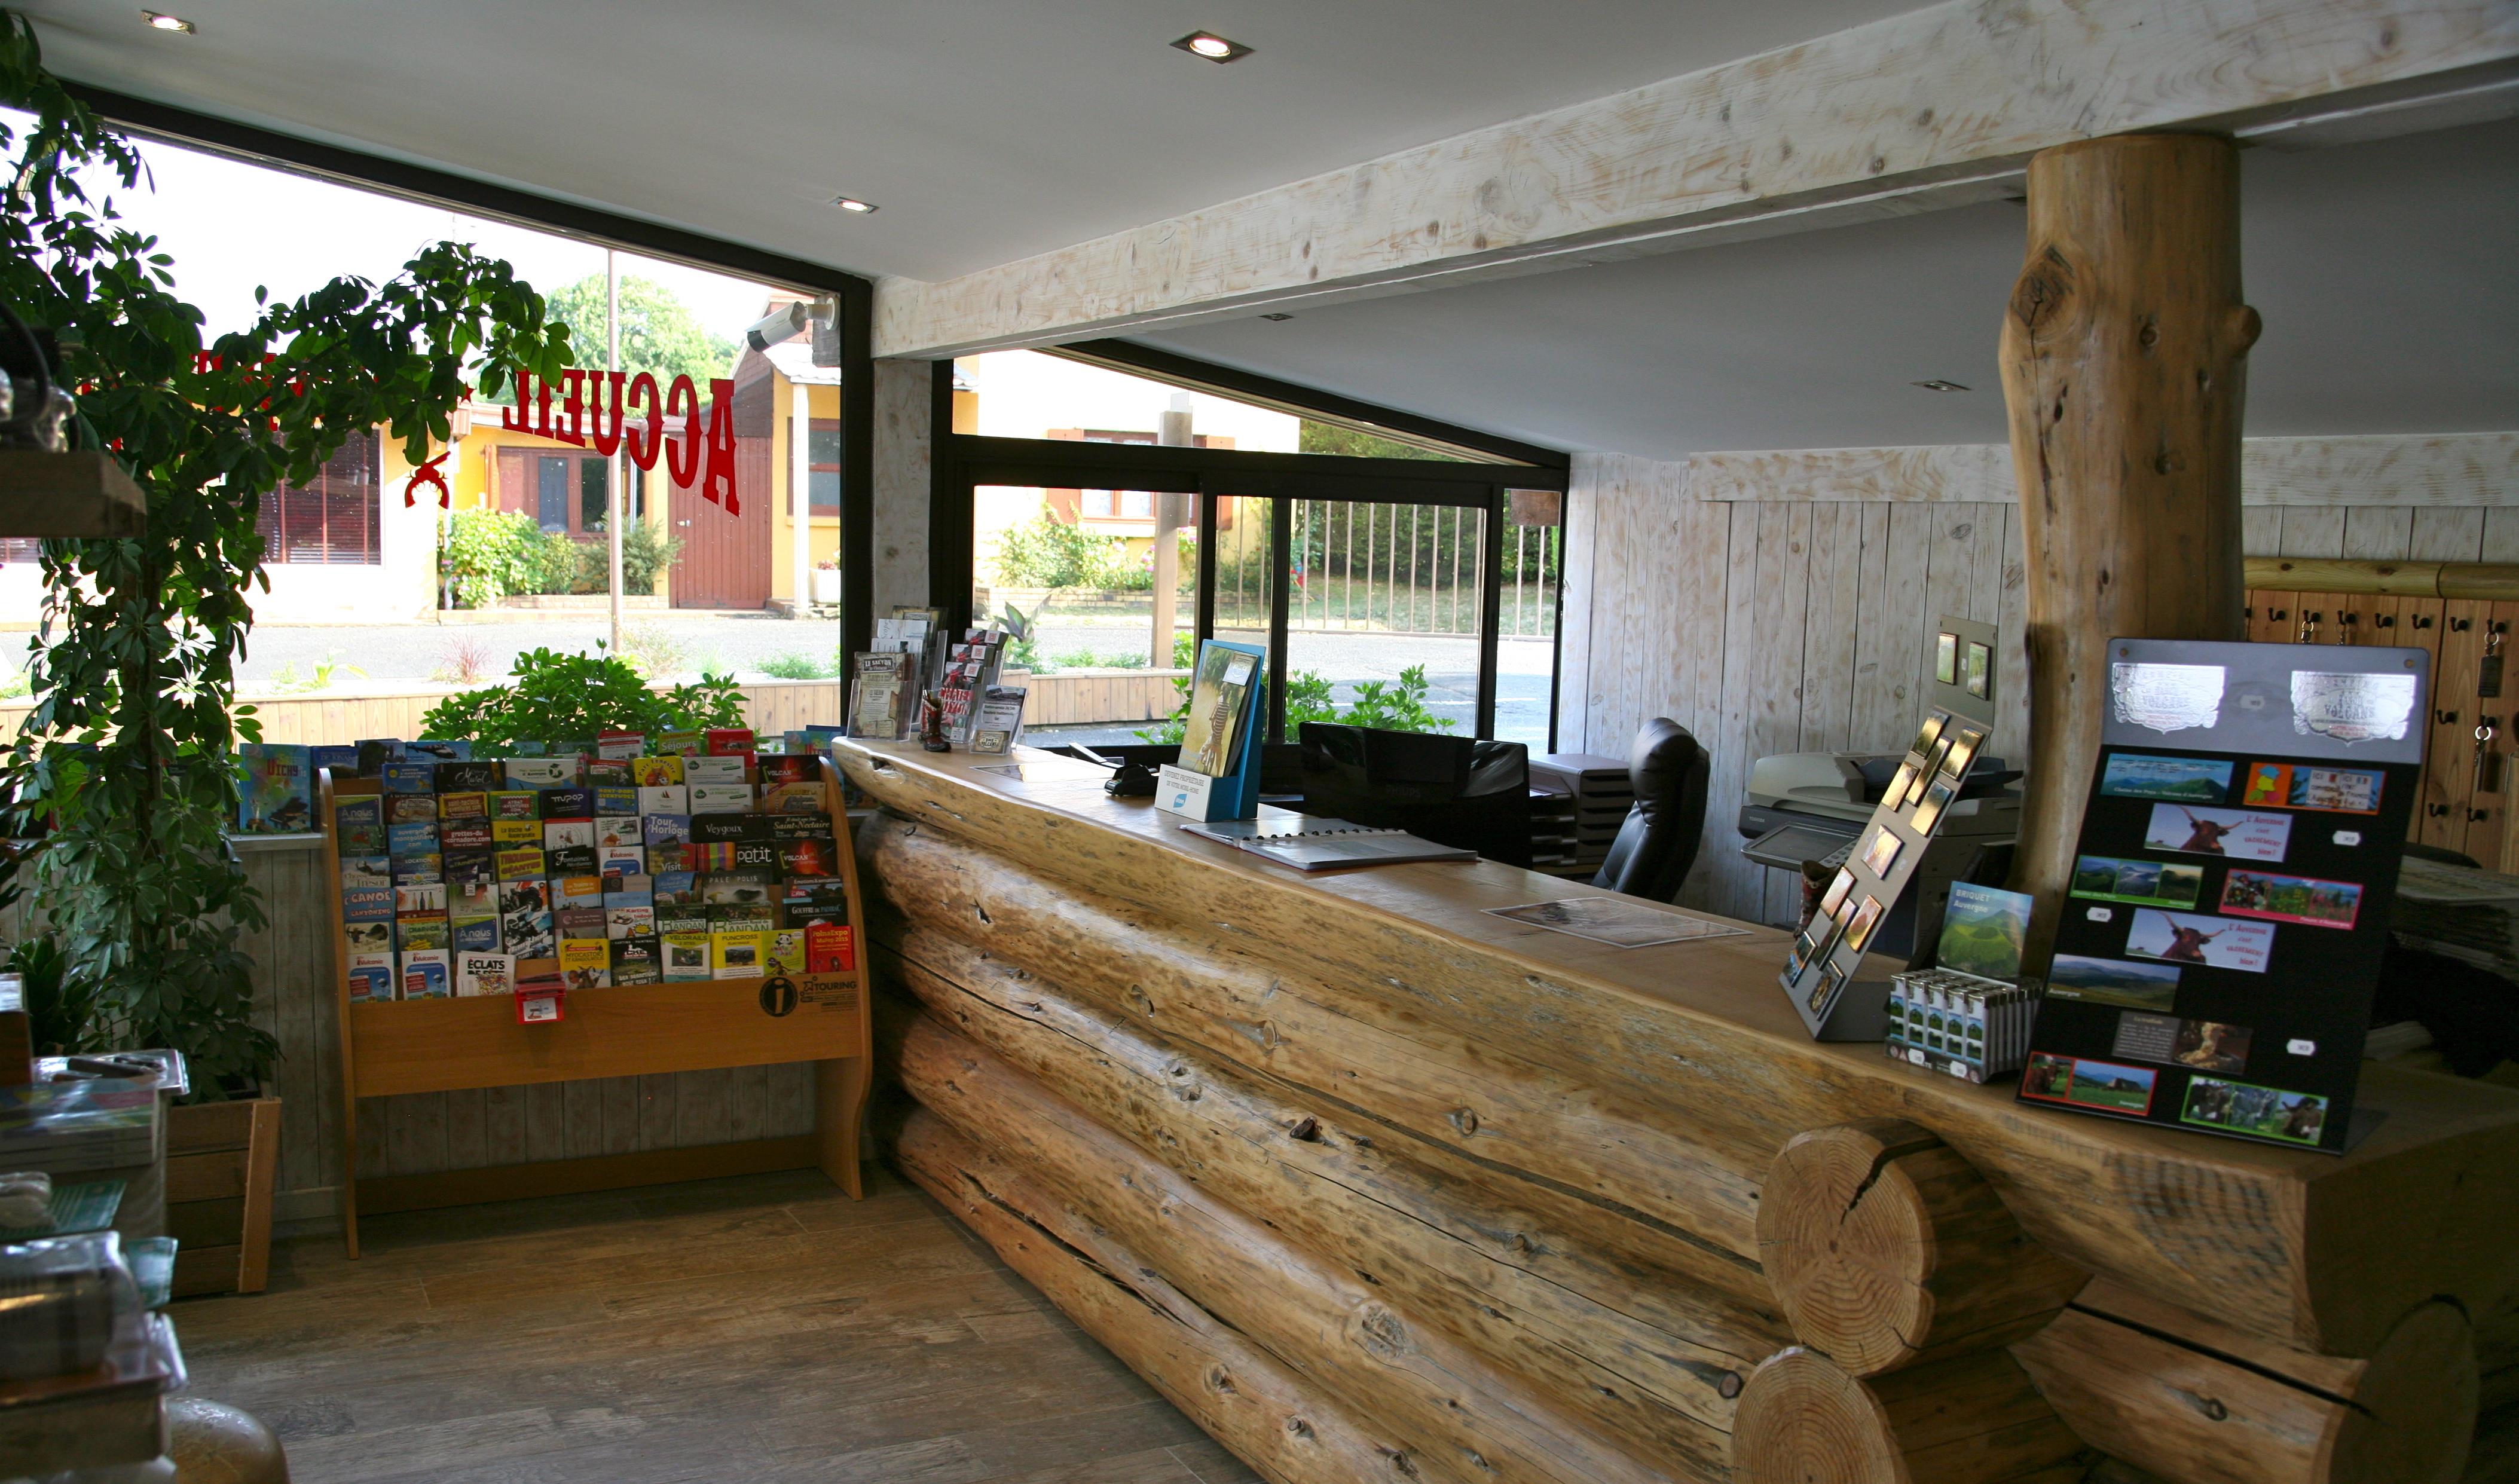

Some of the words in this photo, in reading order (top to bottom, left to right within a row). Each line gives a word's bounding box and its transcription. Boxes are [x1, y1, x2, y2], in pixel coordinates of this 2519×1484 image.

[661, 740, 697, 752] Séjours
[650, 816, 672, 827] Tour
[774, 821, 830, 830] Saint-Nectaire
[705, 824, 743, 836] Veygoux
[737, 846, 772, 862] petit
[1956, 889, 1990, 902] BRIQUET
[1954, 899, 1988, 913] Auvergne
[467, 957, 505, 969] ÉCLATS
[814, 981, 857, 991] TOURING
